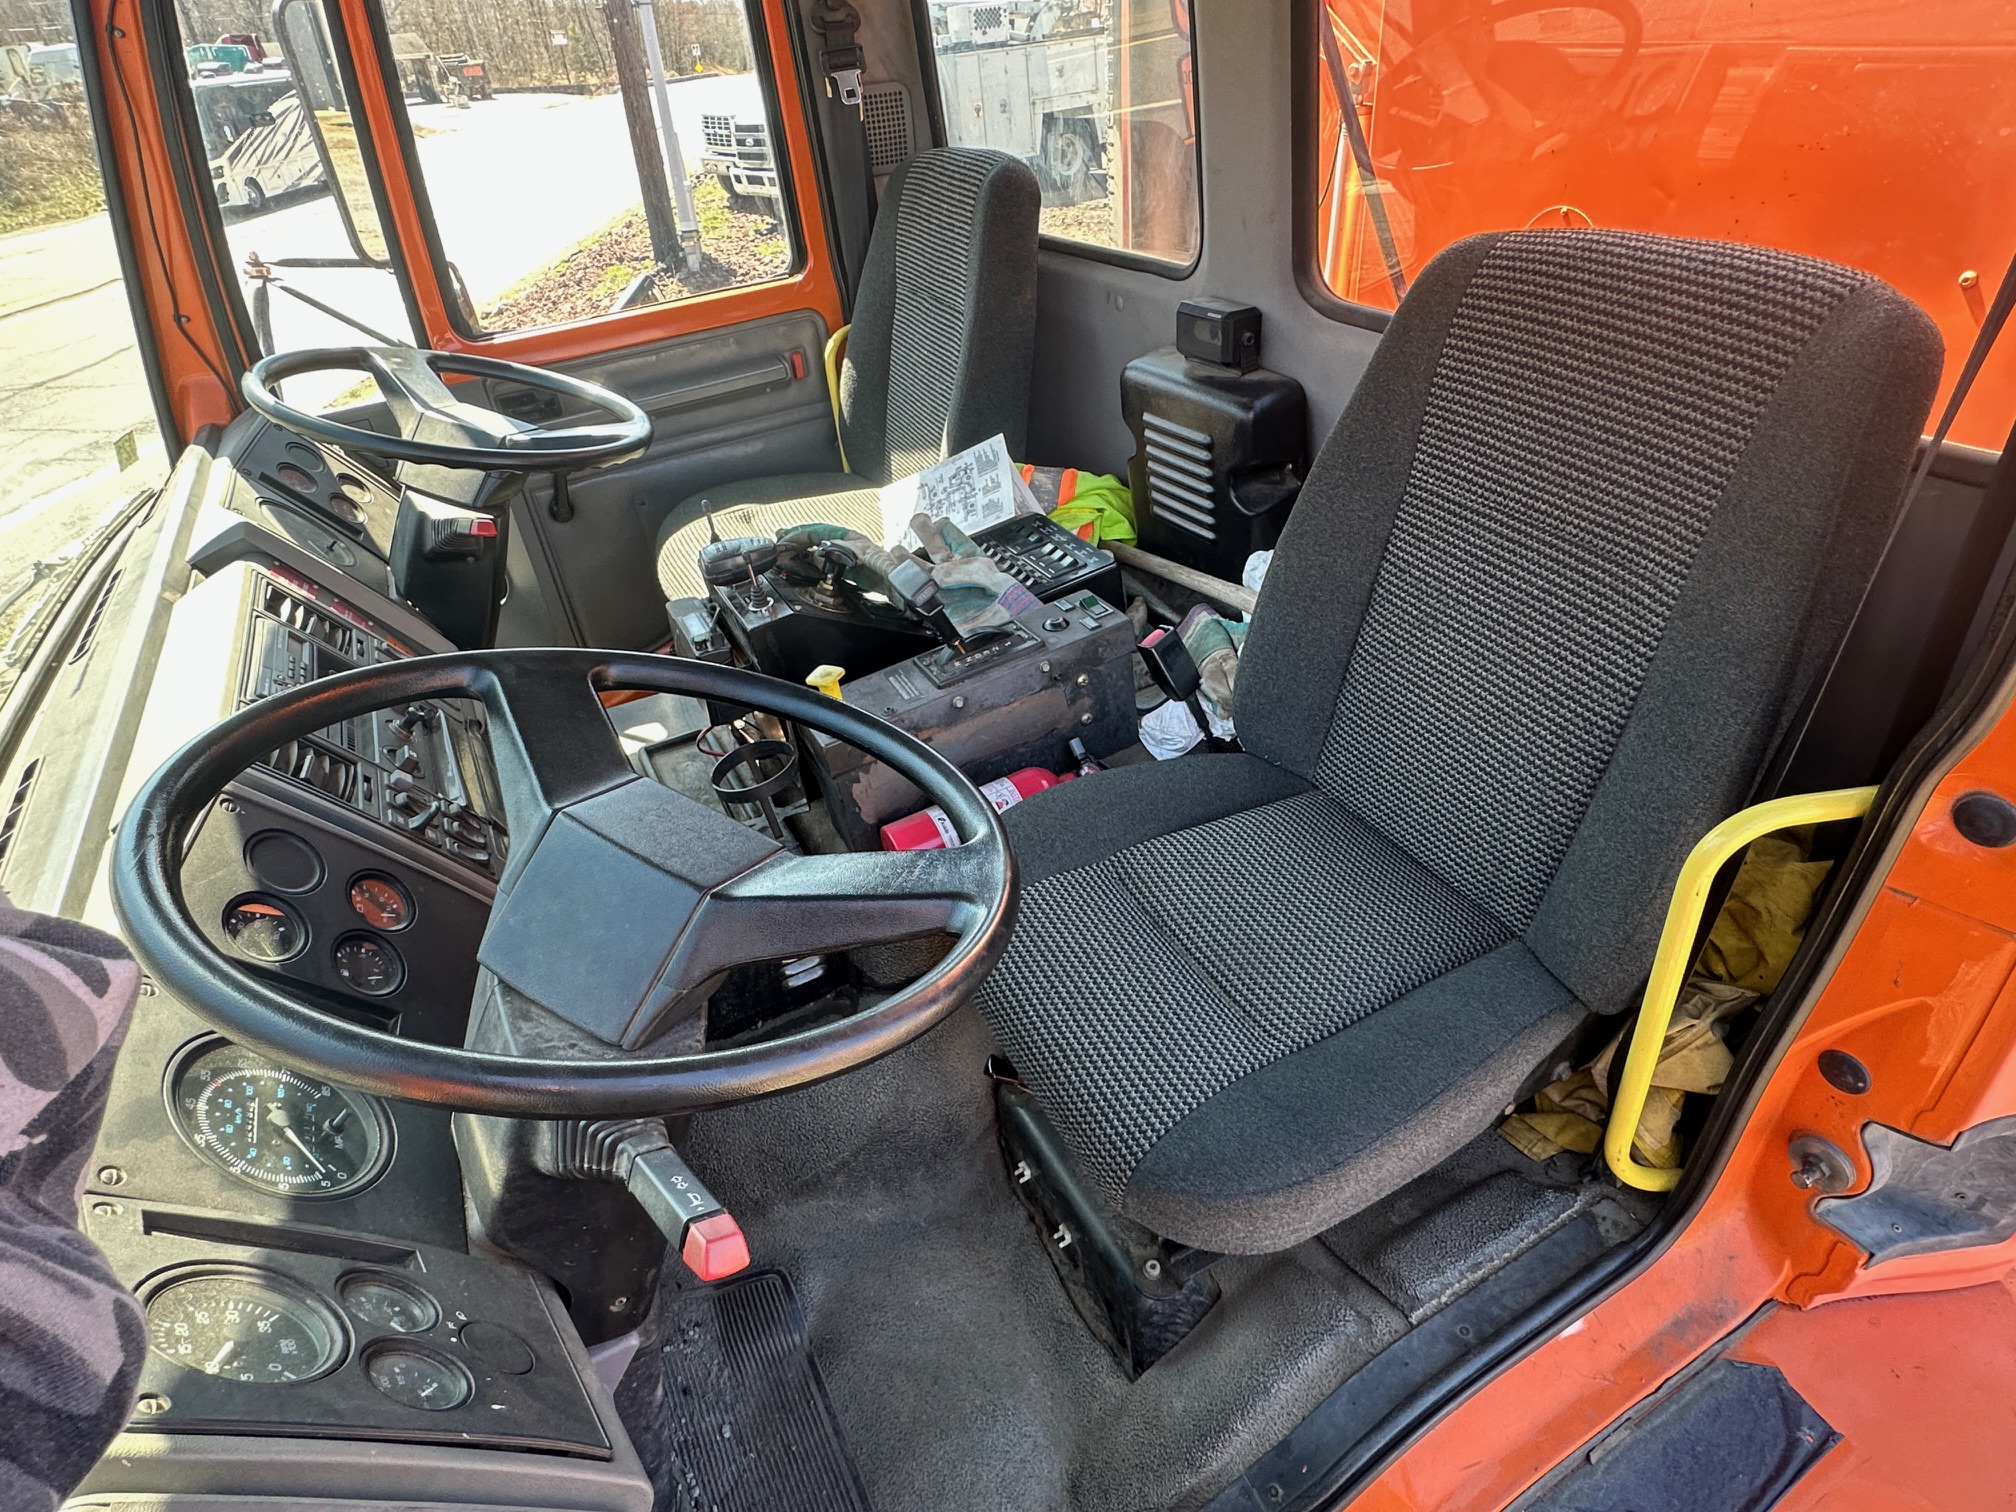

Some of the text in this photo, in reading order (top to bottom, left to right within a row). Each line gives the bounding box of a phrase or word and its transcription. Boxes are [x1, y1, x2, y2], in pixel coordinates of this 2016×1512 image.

[200, 1069, 211, 1081] 55
[185, 1097, 196, 1110] 45
[337, 1172, 347, 1180] 0
[321, 1180, 331, 1188] 5
[195, 1311, 210, 1325] 25
[225, 1310, 240, 1325] 30
[174, 1322, 190, 1337] 20
[257, 1320, 272, 1334] 35
[268, 1363, 282, 1371] 0
[240, 1373, 254, 1381] 5
